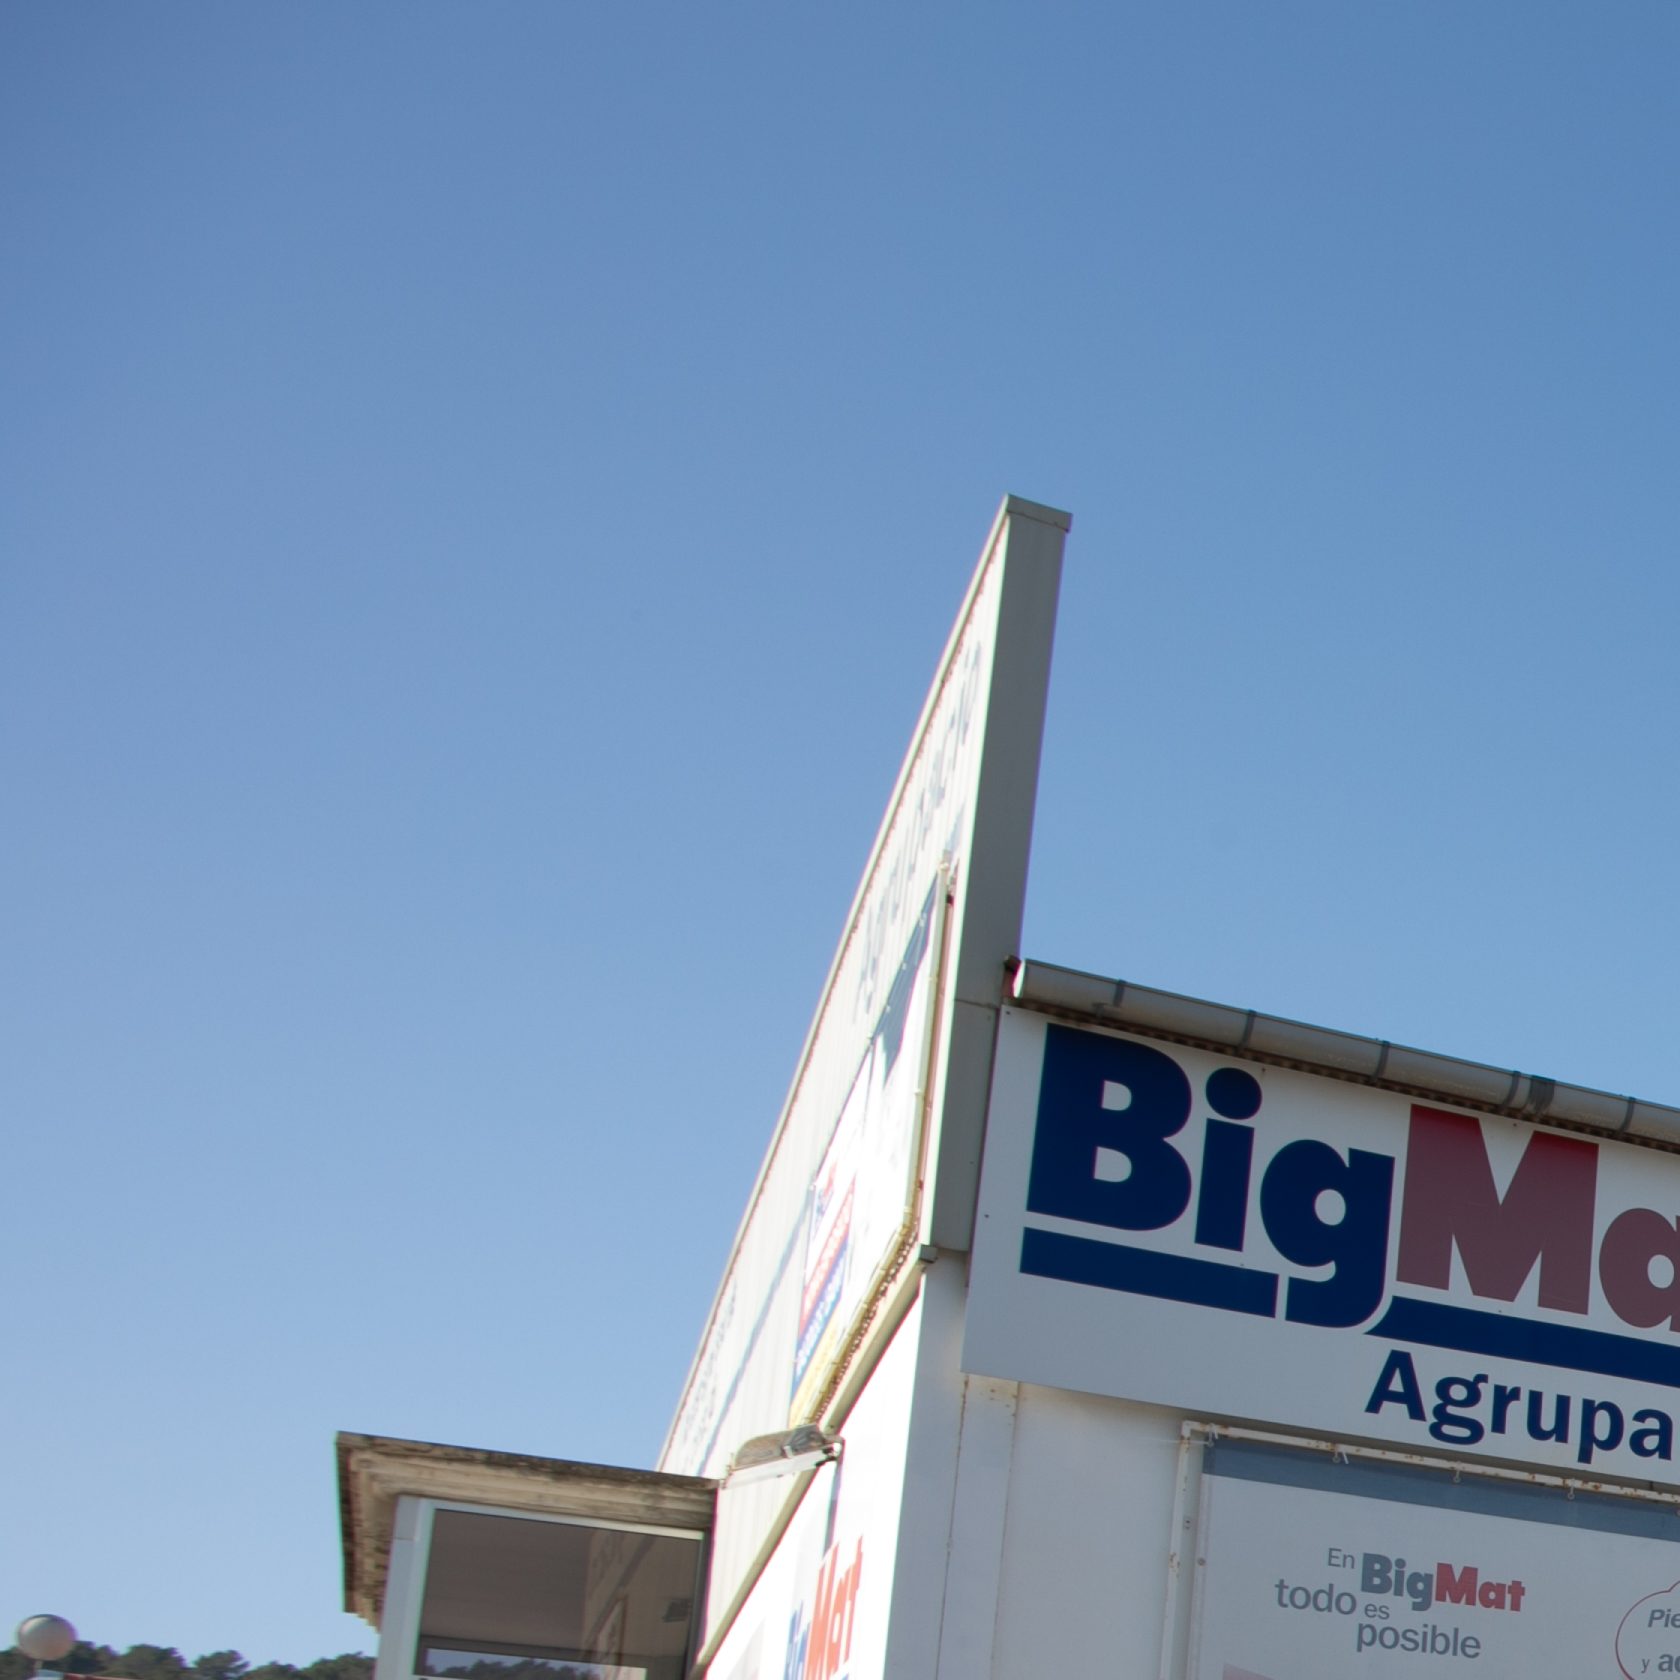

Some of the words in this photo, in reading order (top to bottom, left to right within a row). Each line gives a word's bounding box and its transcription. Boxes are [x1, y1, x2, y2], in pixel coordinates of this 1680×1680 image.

[1274, 1577, 1357, 1617] todo
[1363, 1601, 1391, 1621] es
[1326, 1546, 1356, 1571] En
[1360, 1551, 1527, 1613] BigMat
[1356, 1619, 1482, 1660] posible
[1640, 1655, 1651, 1674] y
